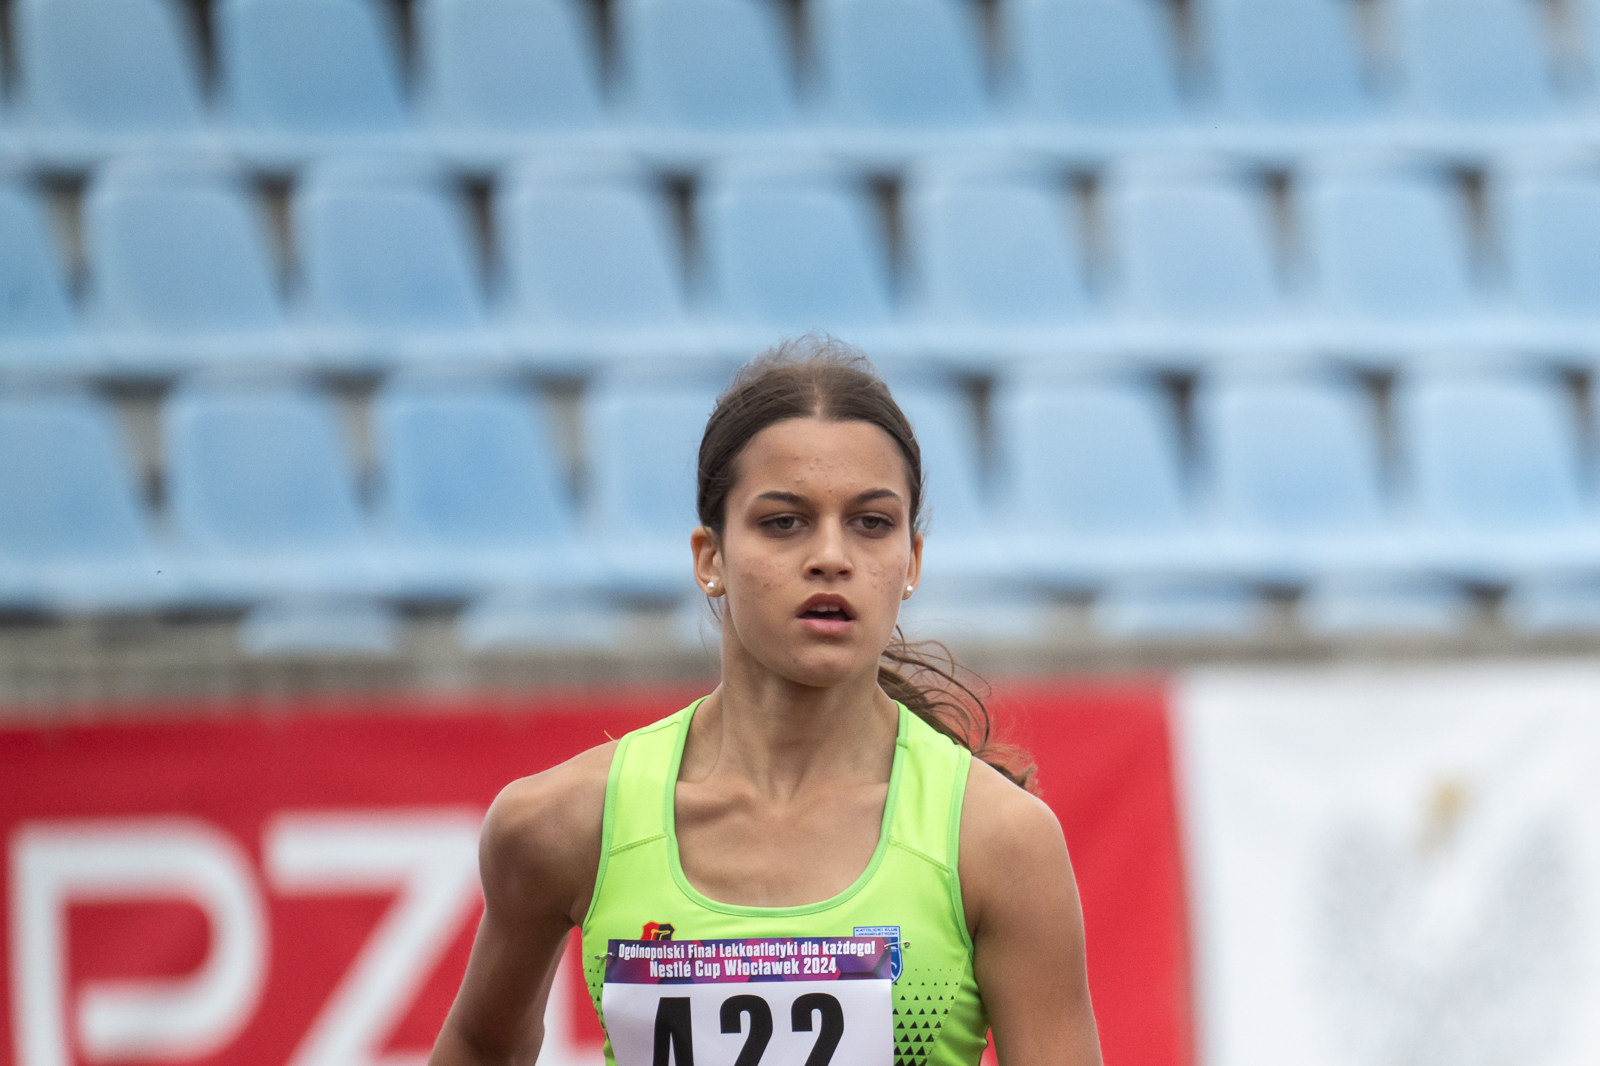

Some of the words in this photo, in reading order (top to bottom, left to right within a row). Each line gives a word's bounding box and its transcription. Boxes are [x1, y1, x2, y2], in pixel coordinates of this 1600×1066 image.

[618, 943, 685, 961] Ogólnopolski
[687, 943, 717, 959] Finał
[719, 941, 798, 959] Lekkoatletyki
[800, 941, 820, 957] dla
[822, 940, 876, 957] każdego!
[649, 960, 692, 978] Nestlé
[694, 960, 721, 980] Cup
[723, 957, 800, 977] Włocławek
[803, 956, 837, 975] 2024
